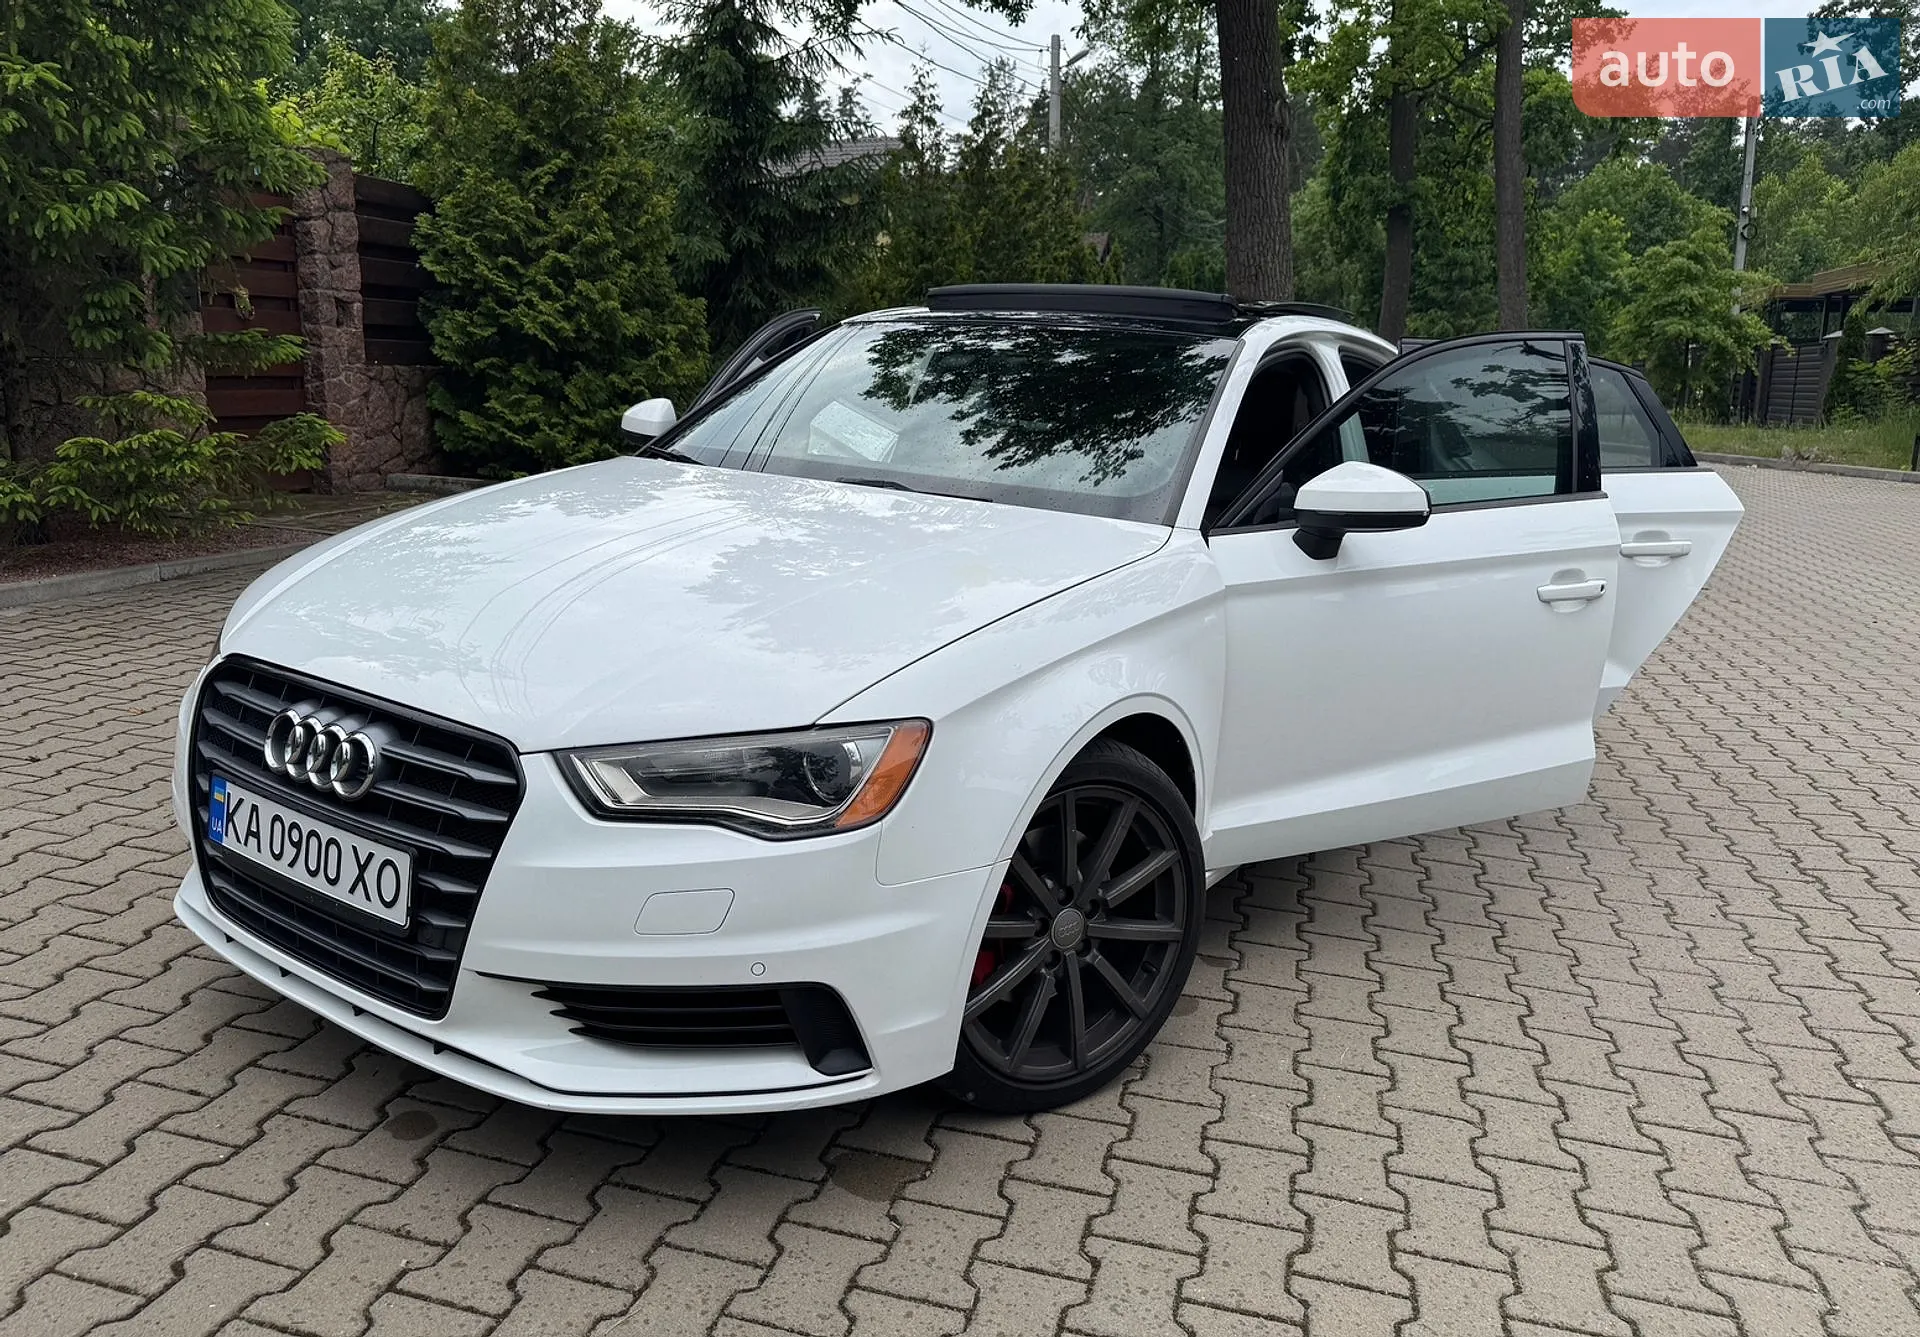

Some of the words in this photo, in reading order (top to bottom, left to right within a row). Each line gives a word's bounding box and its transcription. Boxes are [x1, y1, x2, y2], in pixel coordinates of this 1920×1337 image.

[211, 816, 223, 834] UA
[225, 791, 262, 854] KA
[269, 813, 342, 886] 0900
[348, 844, 401, 909] XO
